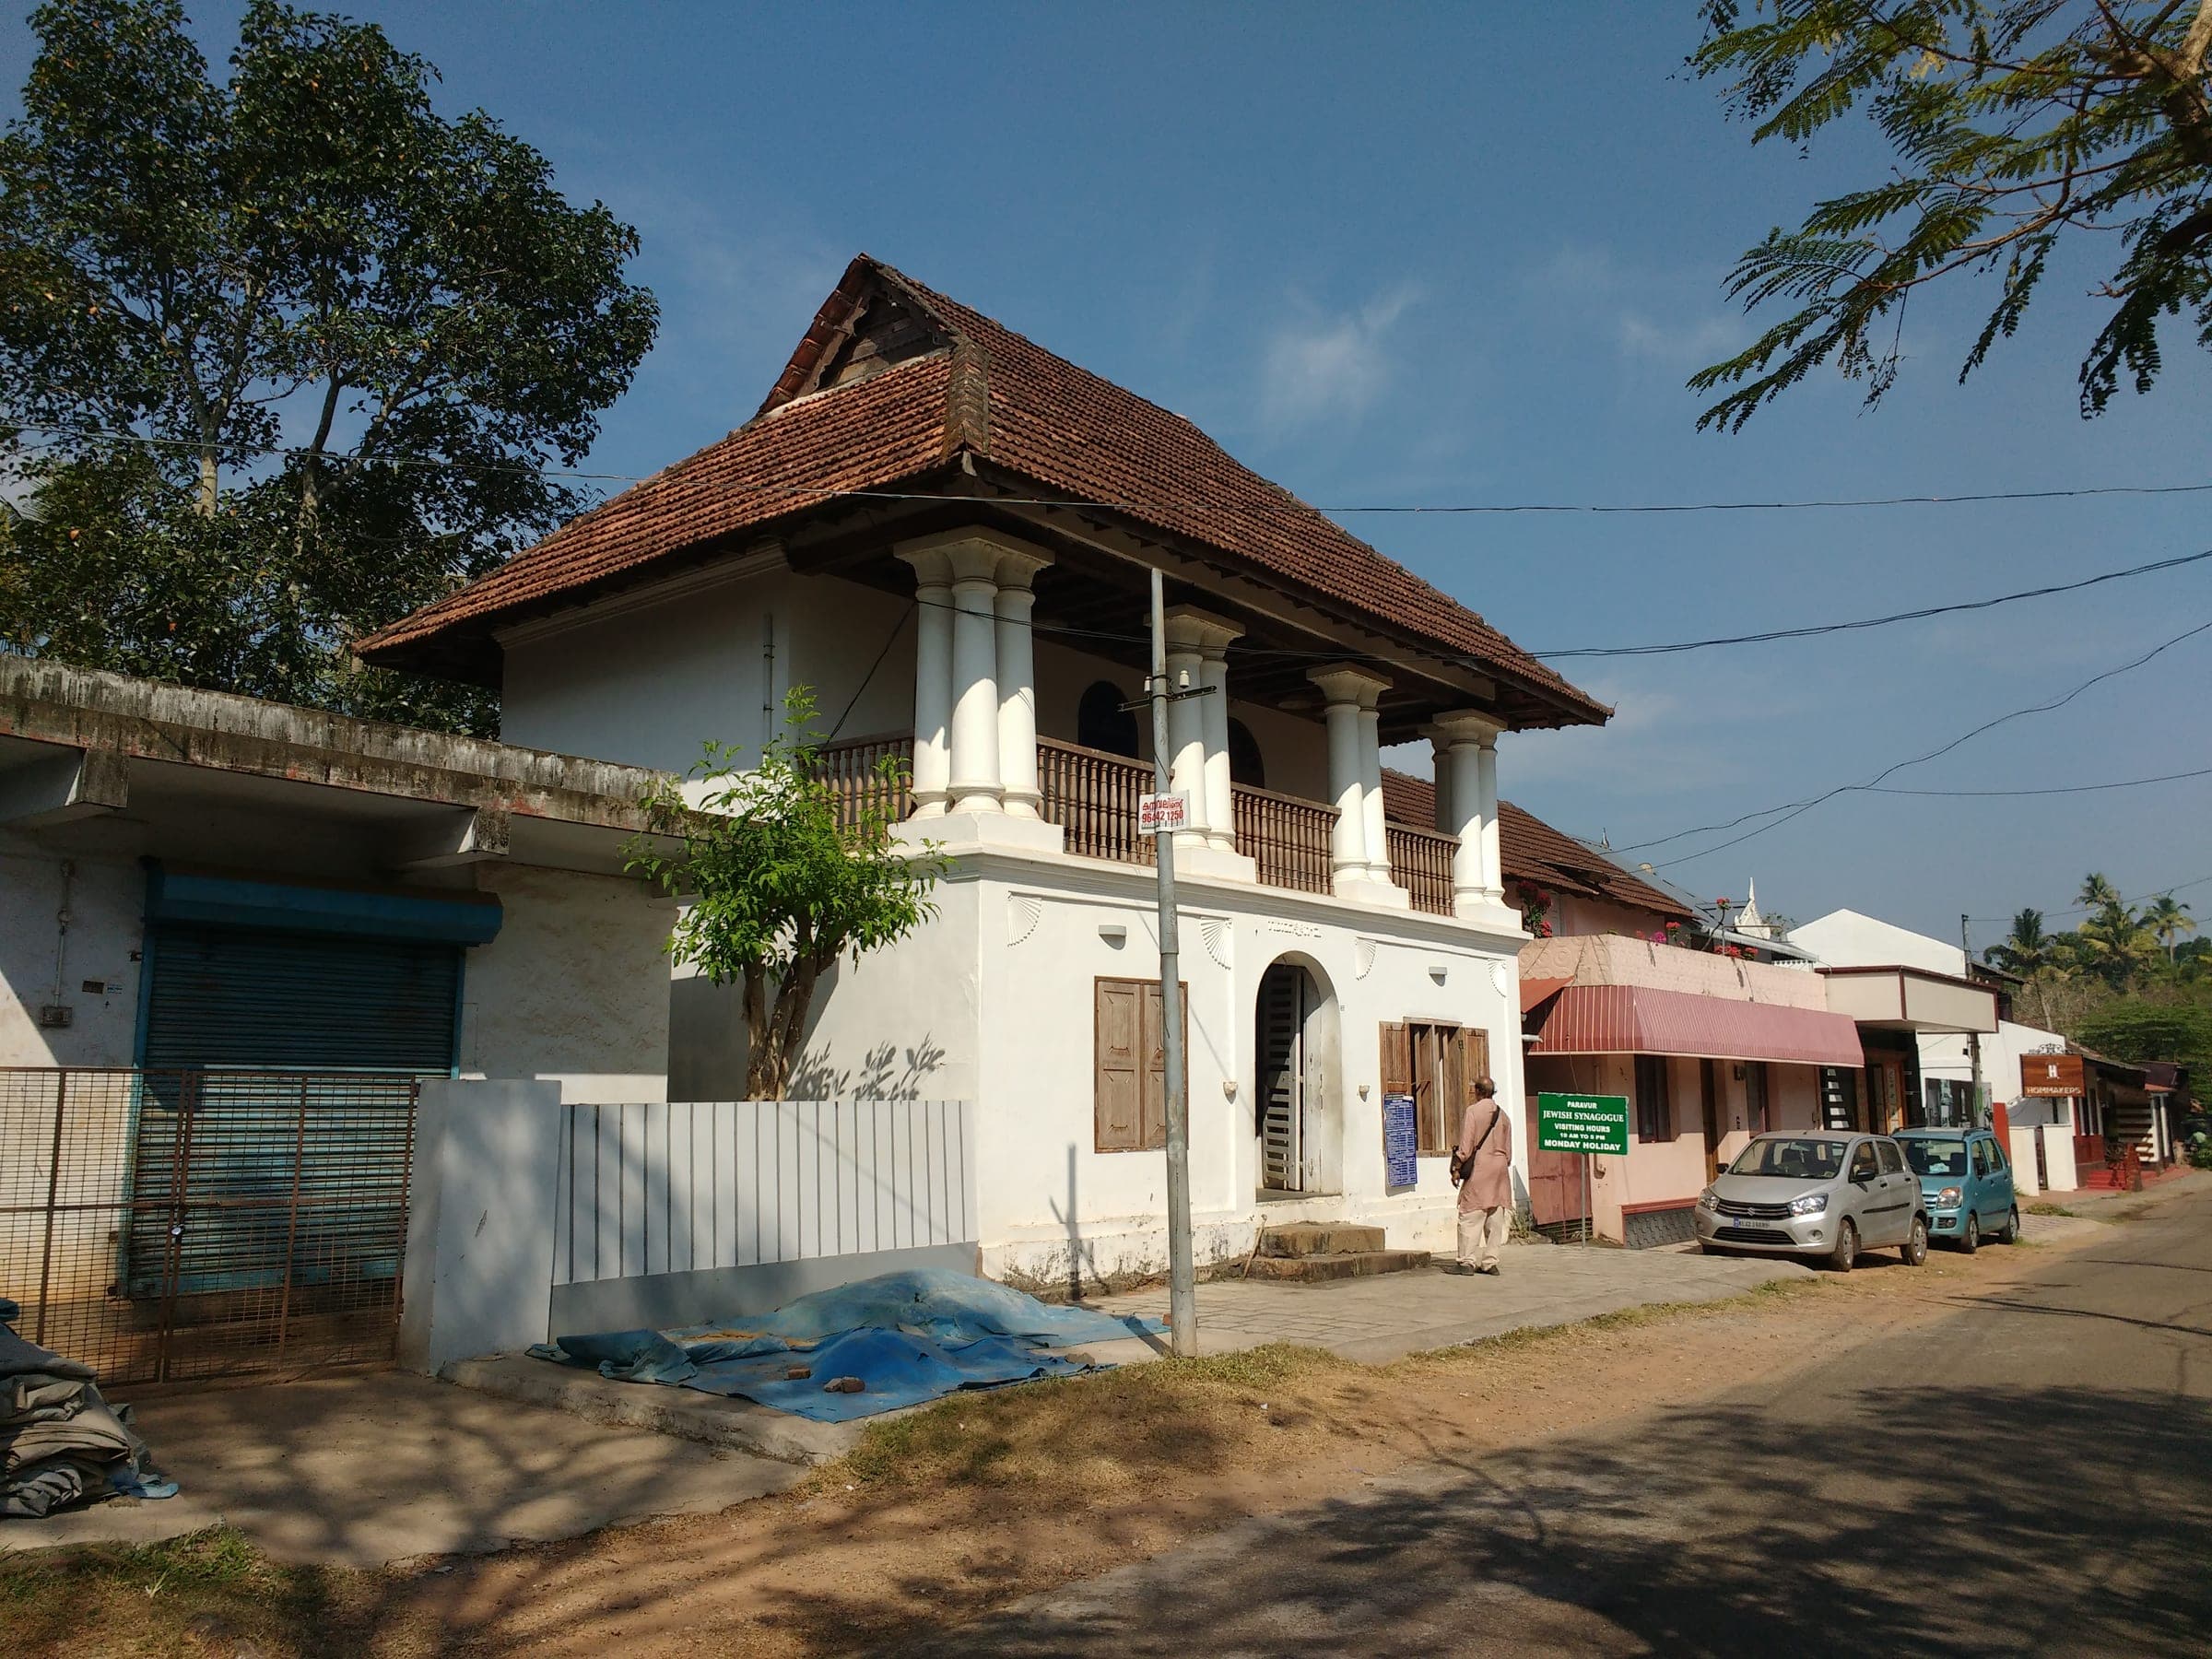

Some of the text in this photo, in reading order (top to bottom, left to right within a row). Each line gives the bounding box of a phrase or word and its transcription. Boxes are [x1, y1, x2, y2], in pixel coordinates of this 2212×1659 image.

[1567, 1100, 1597, 1110] PARAVUR
[1543, 1110, 1624, 1122] JEWISH SYNAGOGUE
[1554, 1123, 1611, 1133] VISITING HOURS
[1544, 1139, 1621, 1151] MONDAY HOLIDAY
